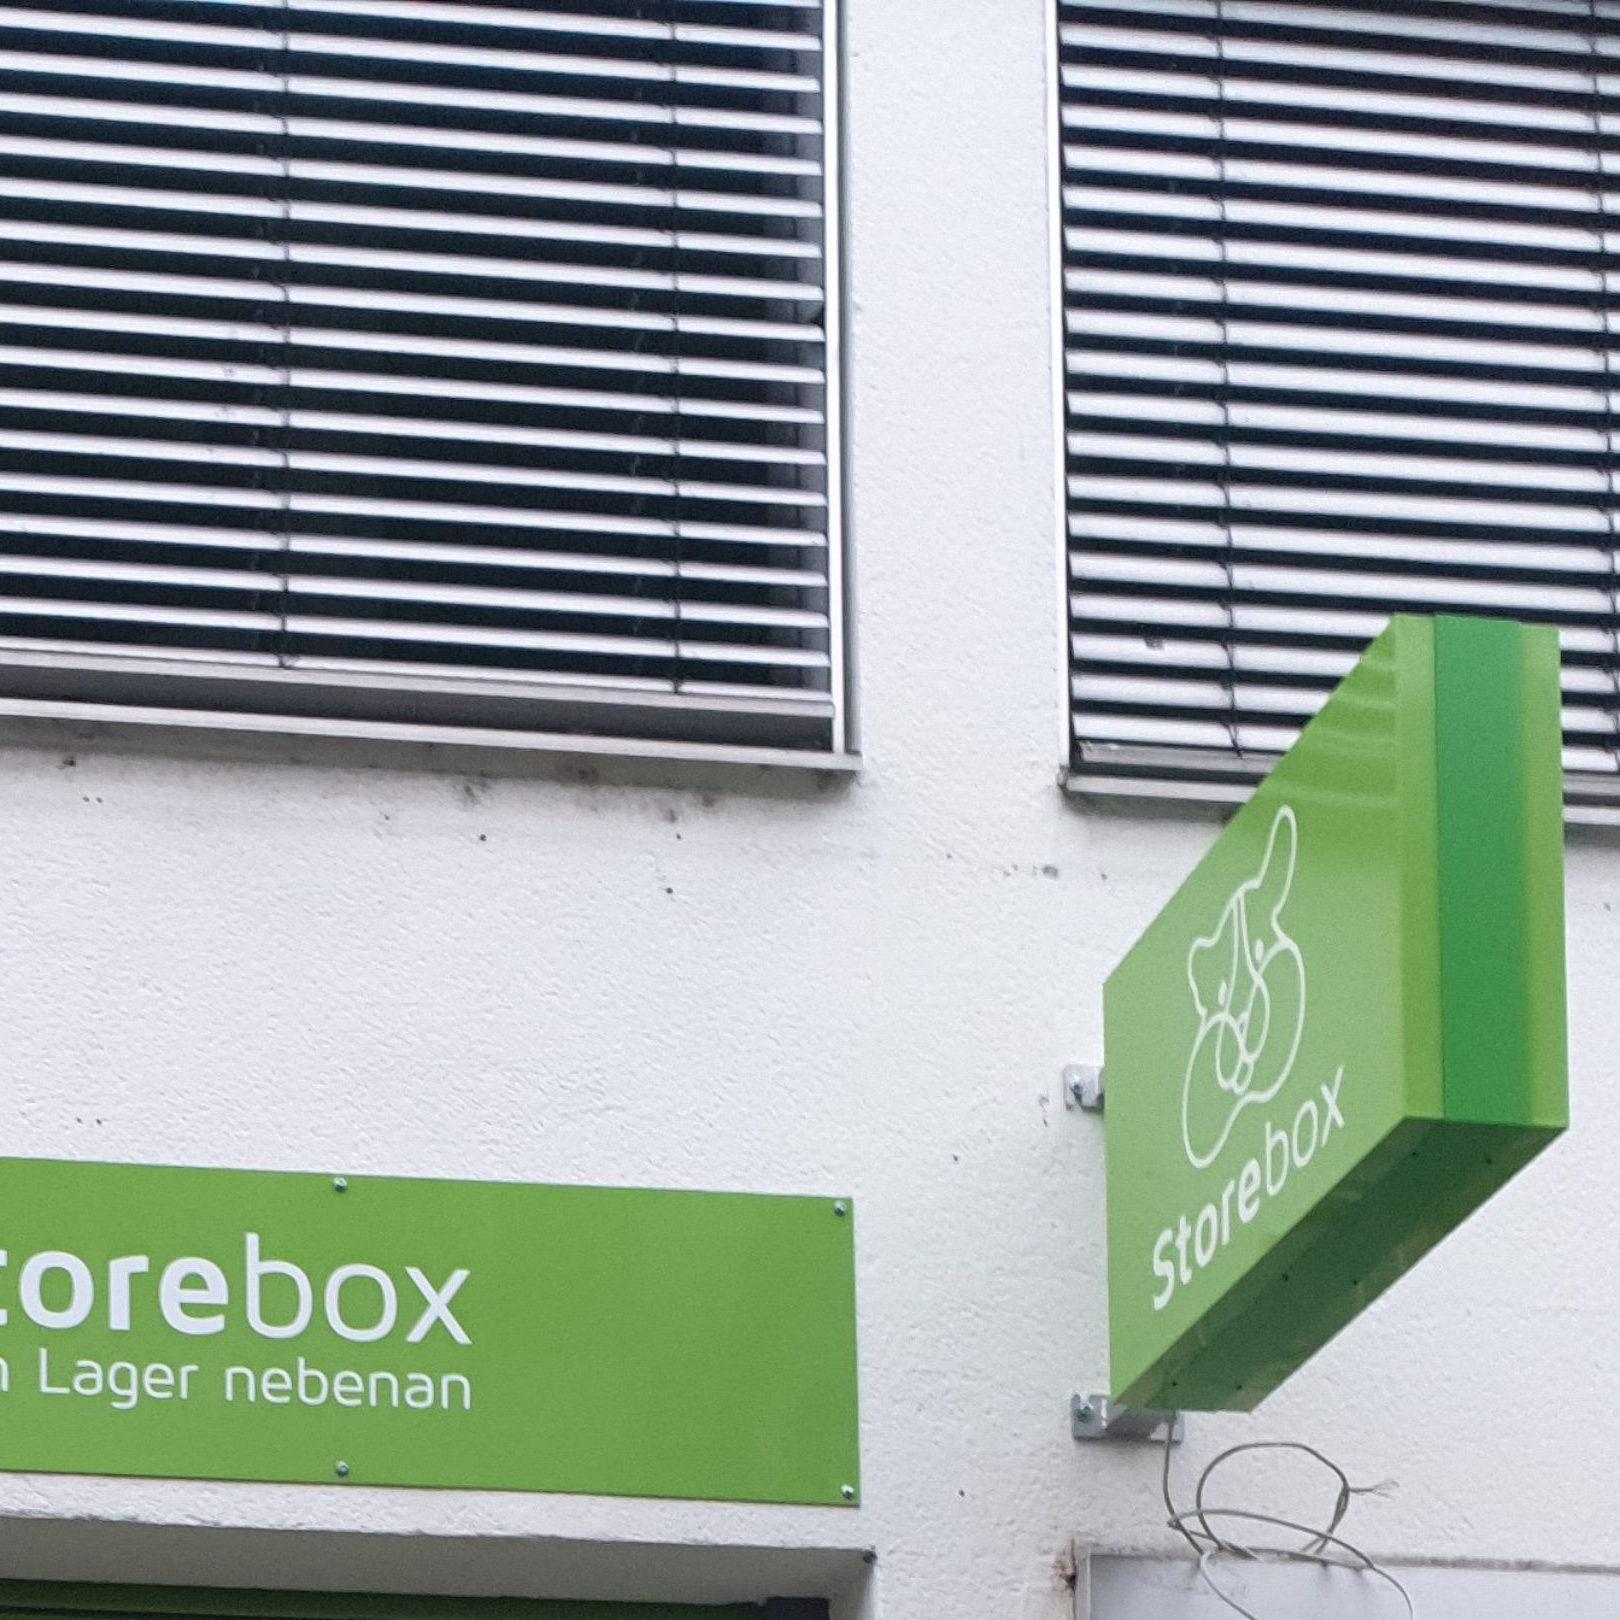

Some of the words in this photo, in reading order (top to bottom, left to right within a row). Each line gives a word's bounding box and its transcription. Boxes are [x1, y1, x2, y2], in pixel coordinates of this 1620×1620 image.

[1153, 1062, 1346, 1312] Storebox
[37, 1347, 200, 1411] Lager
[223, 1357, 473, 1411] nebenan
